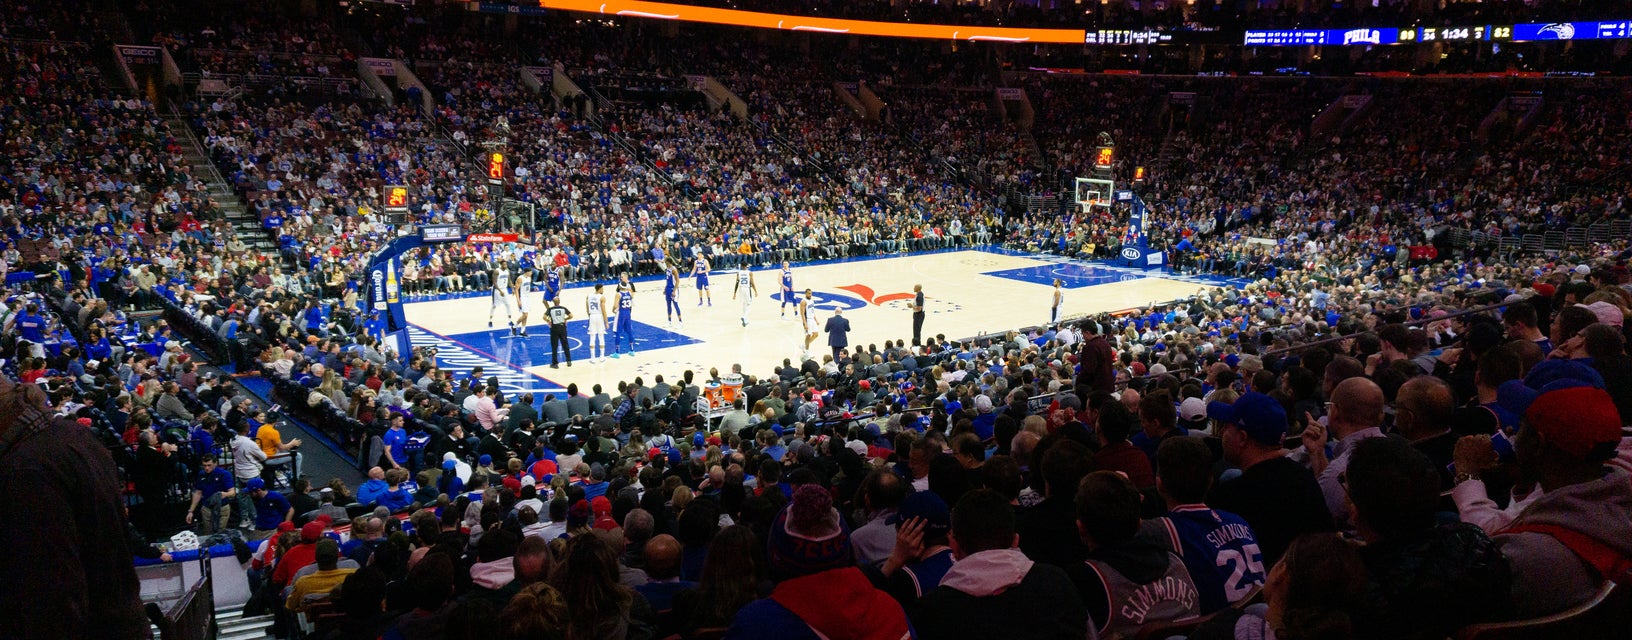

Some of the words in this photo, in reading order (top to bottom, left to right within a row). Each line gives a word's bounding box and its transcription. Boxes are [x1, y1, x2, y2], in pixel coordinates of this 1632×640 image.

[1343, 28, 1380, 45] PHILA
[1400, 30, 1415, 40] 89
[1423, 32, 1435, 40] 24
[1441, 28, 1469, 39] 1:34
[1494, 27, 1510, 38] 82
[1099, 154, 1110, 165] 24
[491, 162, 502, 177] 24
[389, 195, 404, 205] 24
[1124, 250, 1138, 258] KIA
[372, 270, 383, 301] Corona
[621, 300, 632, 309] 33
[1205, 523, 1254, 549] SIMMONS
[1215, 543, 1267, 604] 25
[1121, 576, 1196, 625] SIMMONS
